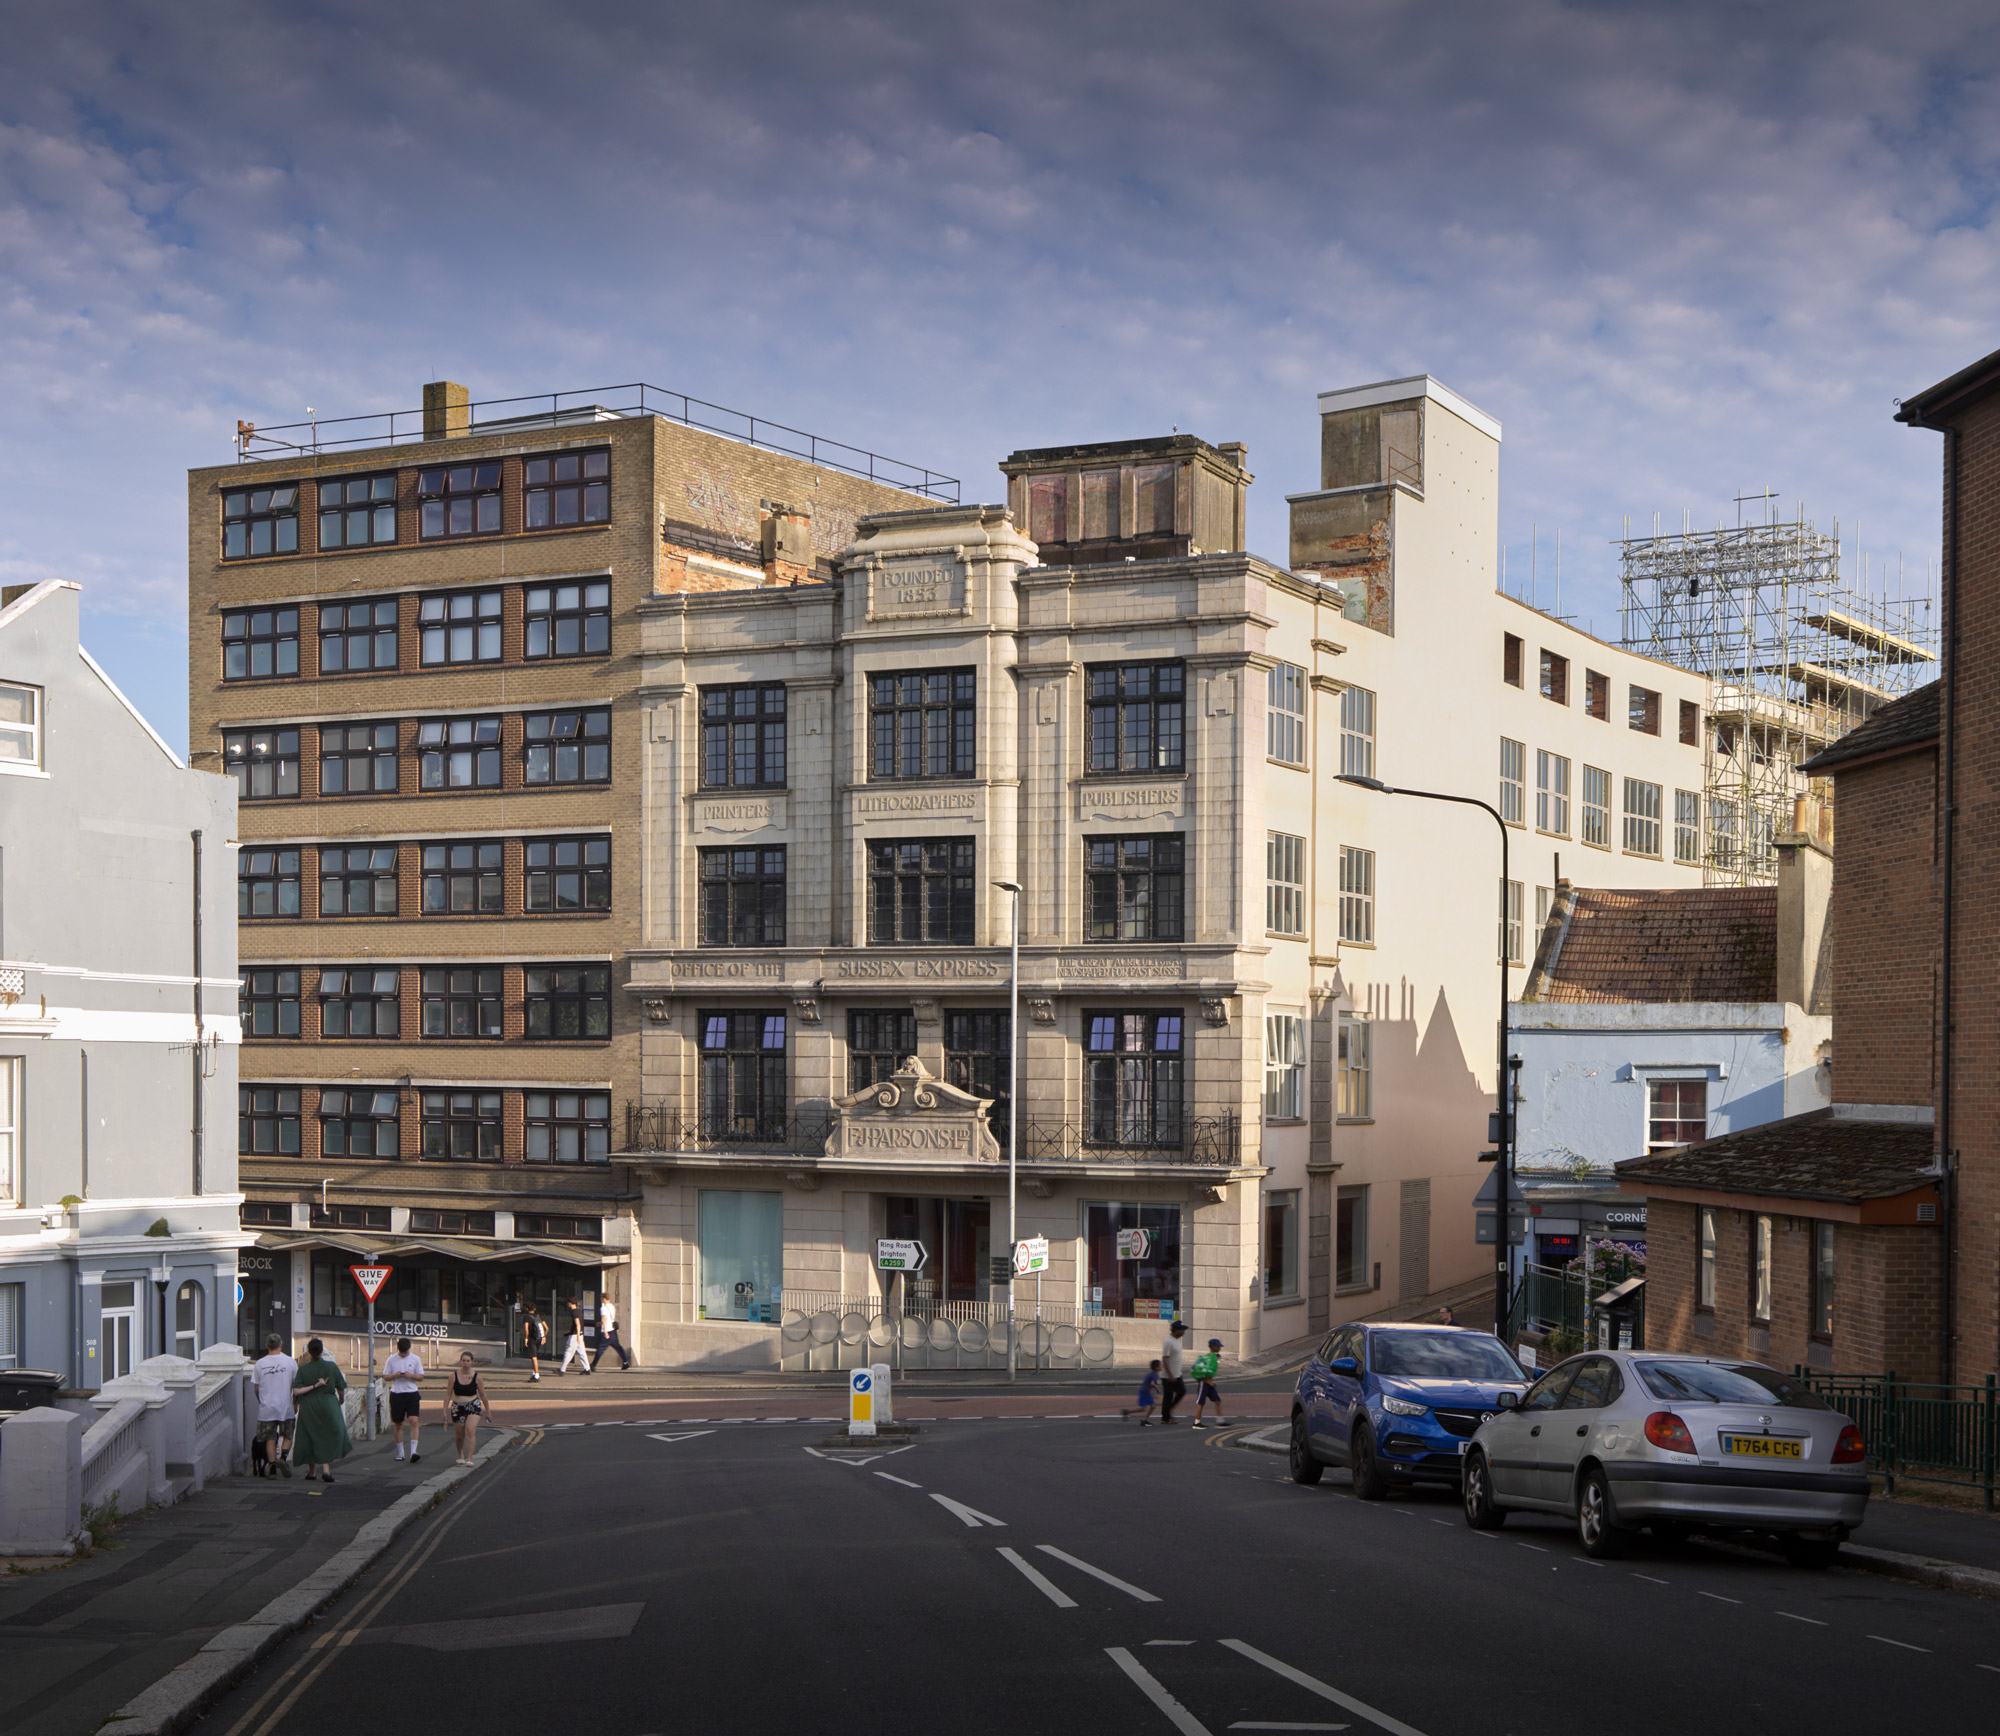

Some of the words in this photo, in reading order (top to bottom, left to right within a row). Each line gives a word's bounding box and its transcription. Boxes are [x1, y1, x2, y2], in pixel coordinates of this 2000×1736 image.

[881, 568, 954, 587] FOUNDED
[858, 794, 977, 812] LITHOGRAPHERS
[1082, 789, 1180, 806] PUBLISHERS
[703, 804, 775, 819] PRINTERS
[671, 963, 723, 977] OFFICE
[728, 963, 750, 977] OF
[753, 963, 782, 977] THE
[838, 960, 905, 977] SUSSEX
[915, 960, 1000, 977] EXPRESS
[1058, 967, 1110, 977] NEWSPAPER
[880, 1241, 894, 1249] Ring
[880, 1250, 907, 1258] Brighton
[880, 1259, 905, 1267] (A259)
[358, 1270, 382, 1278] GIVE
[405, 1323, 448, 1338] HOUSE
[1734, 1439, 1770, 1454] T764
[1774, 1442, 1800, 1456] CFG
